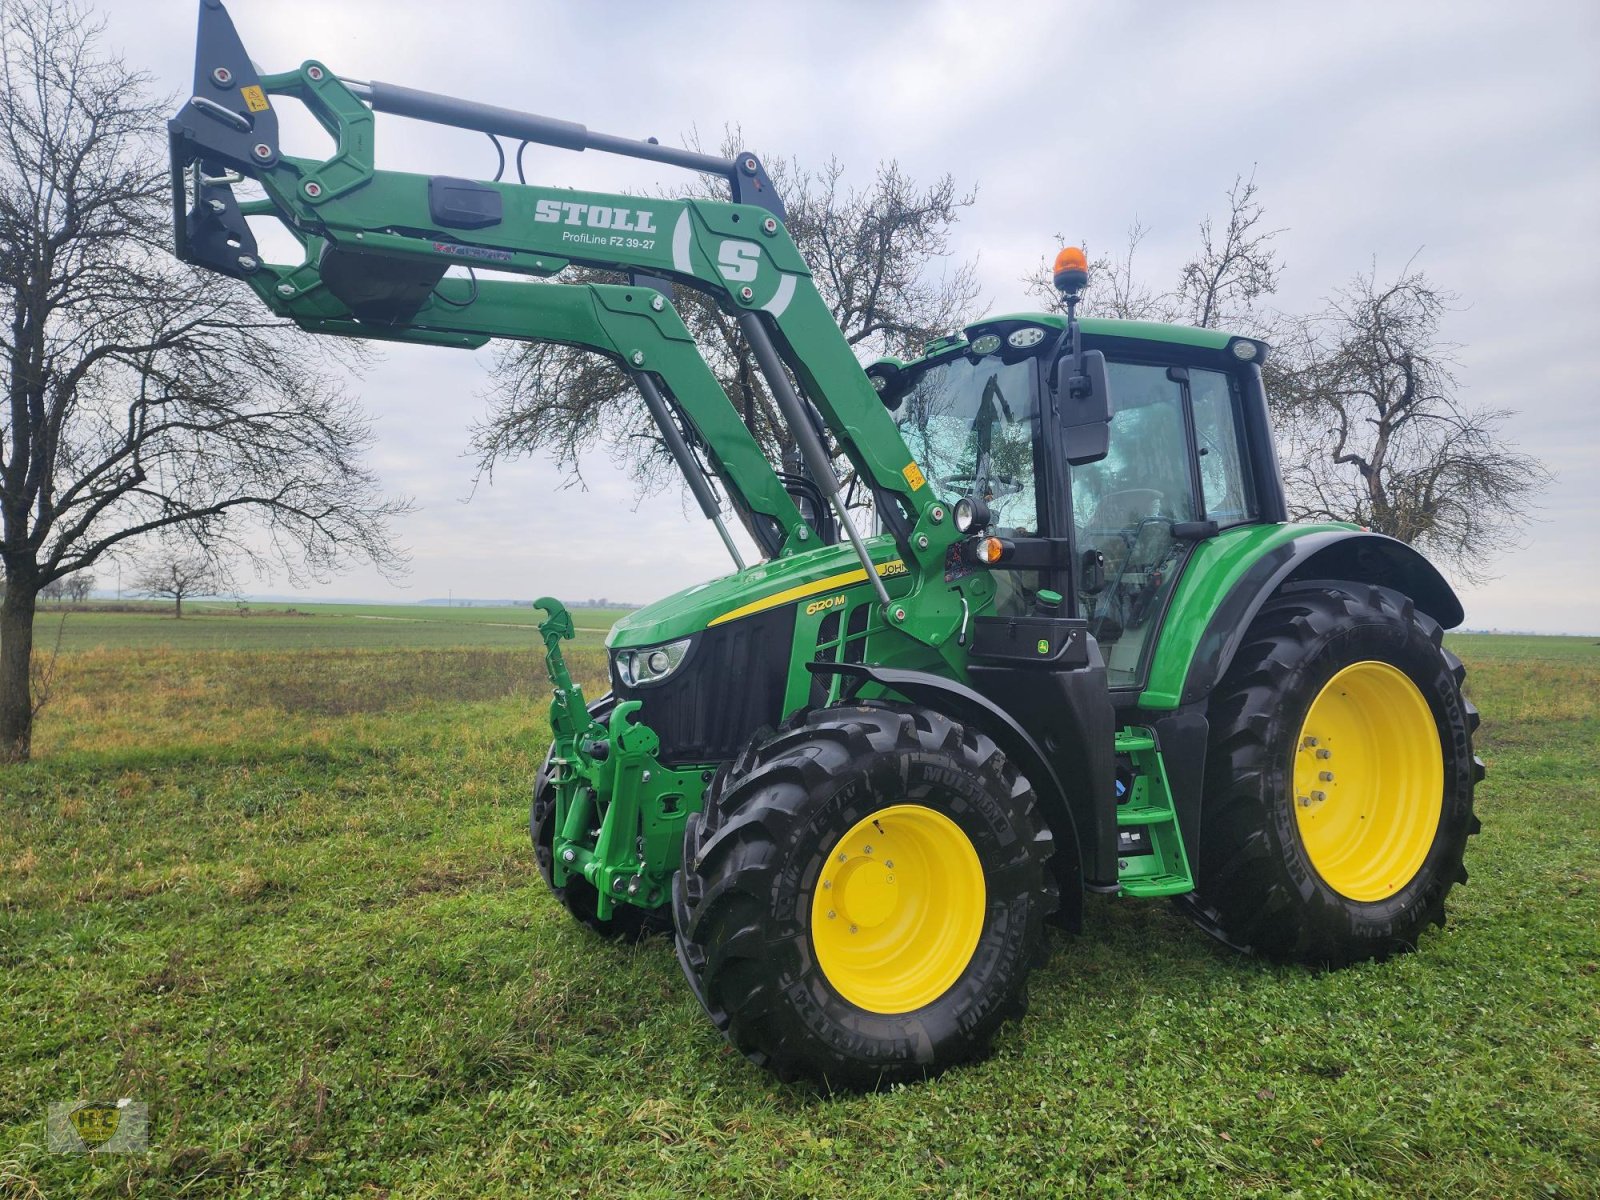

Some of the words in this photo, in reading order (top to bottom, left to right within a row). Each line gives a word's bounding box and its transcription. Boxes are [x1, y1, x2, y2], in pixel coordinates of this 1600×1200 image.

[534, 199, 656, 233] STOLL
[562, 231, 607, 246] ProfiLine
[609, 236, 624, 247] FZ
[626, 238, 655, 249] 39-27
[717, 239, 761, 282] S
[806, 598, 833, 615] 6120
[835, 594, 845, 606] M
